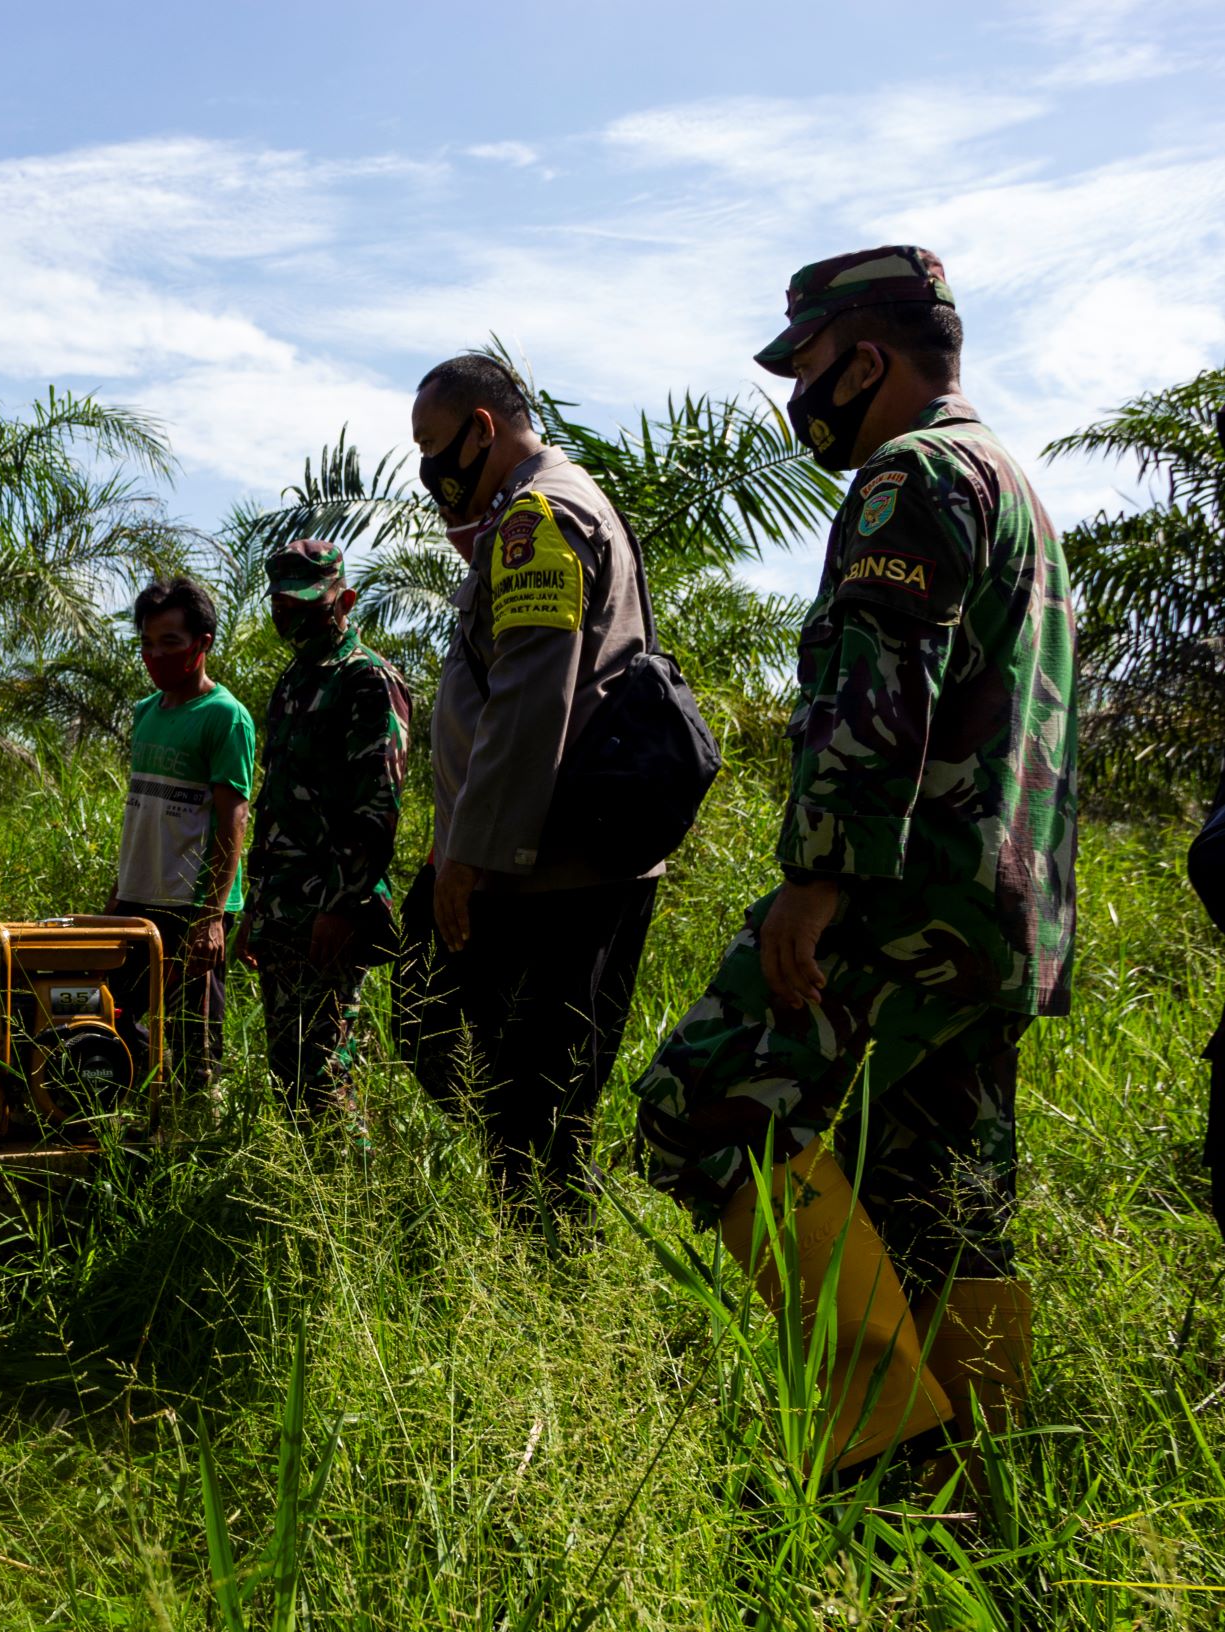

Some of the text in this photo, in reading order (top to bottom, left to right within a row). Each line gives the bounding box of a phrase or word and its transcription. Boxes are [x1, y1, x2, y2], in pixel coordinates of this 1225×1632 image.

[536, 592, 559, 601] JAYA
[510, 604, 559, 614] BETARA
[81, 1068, 114, 1079] Robin
